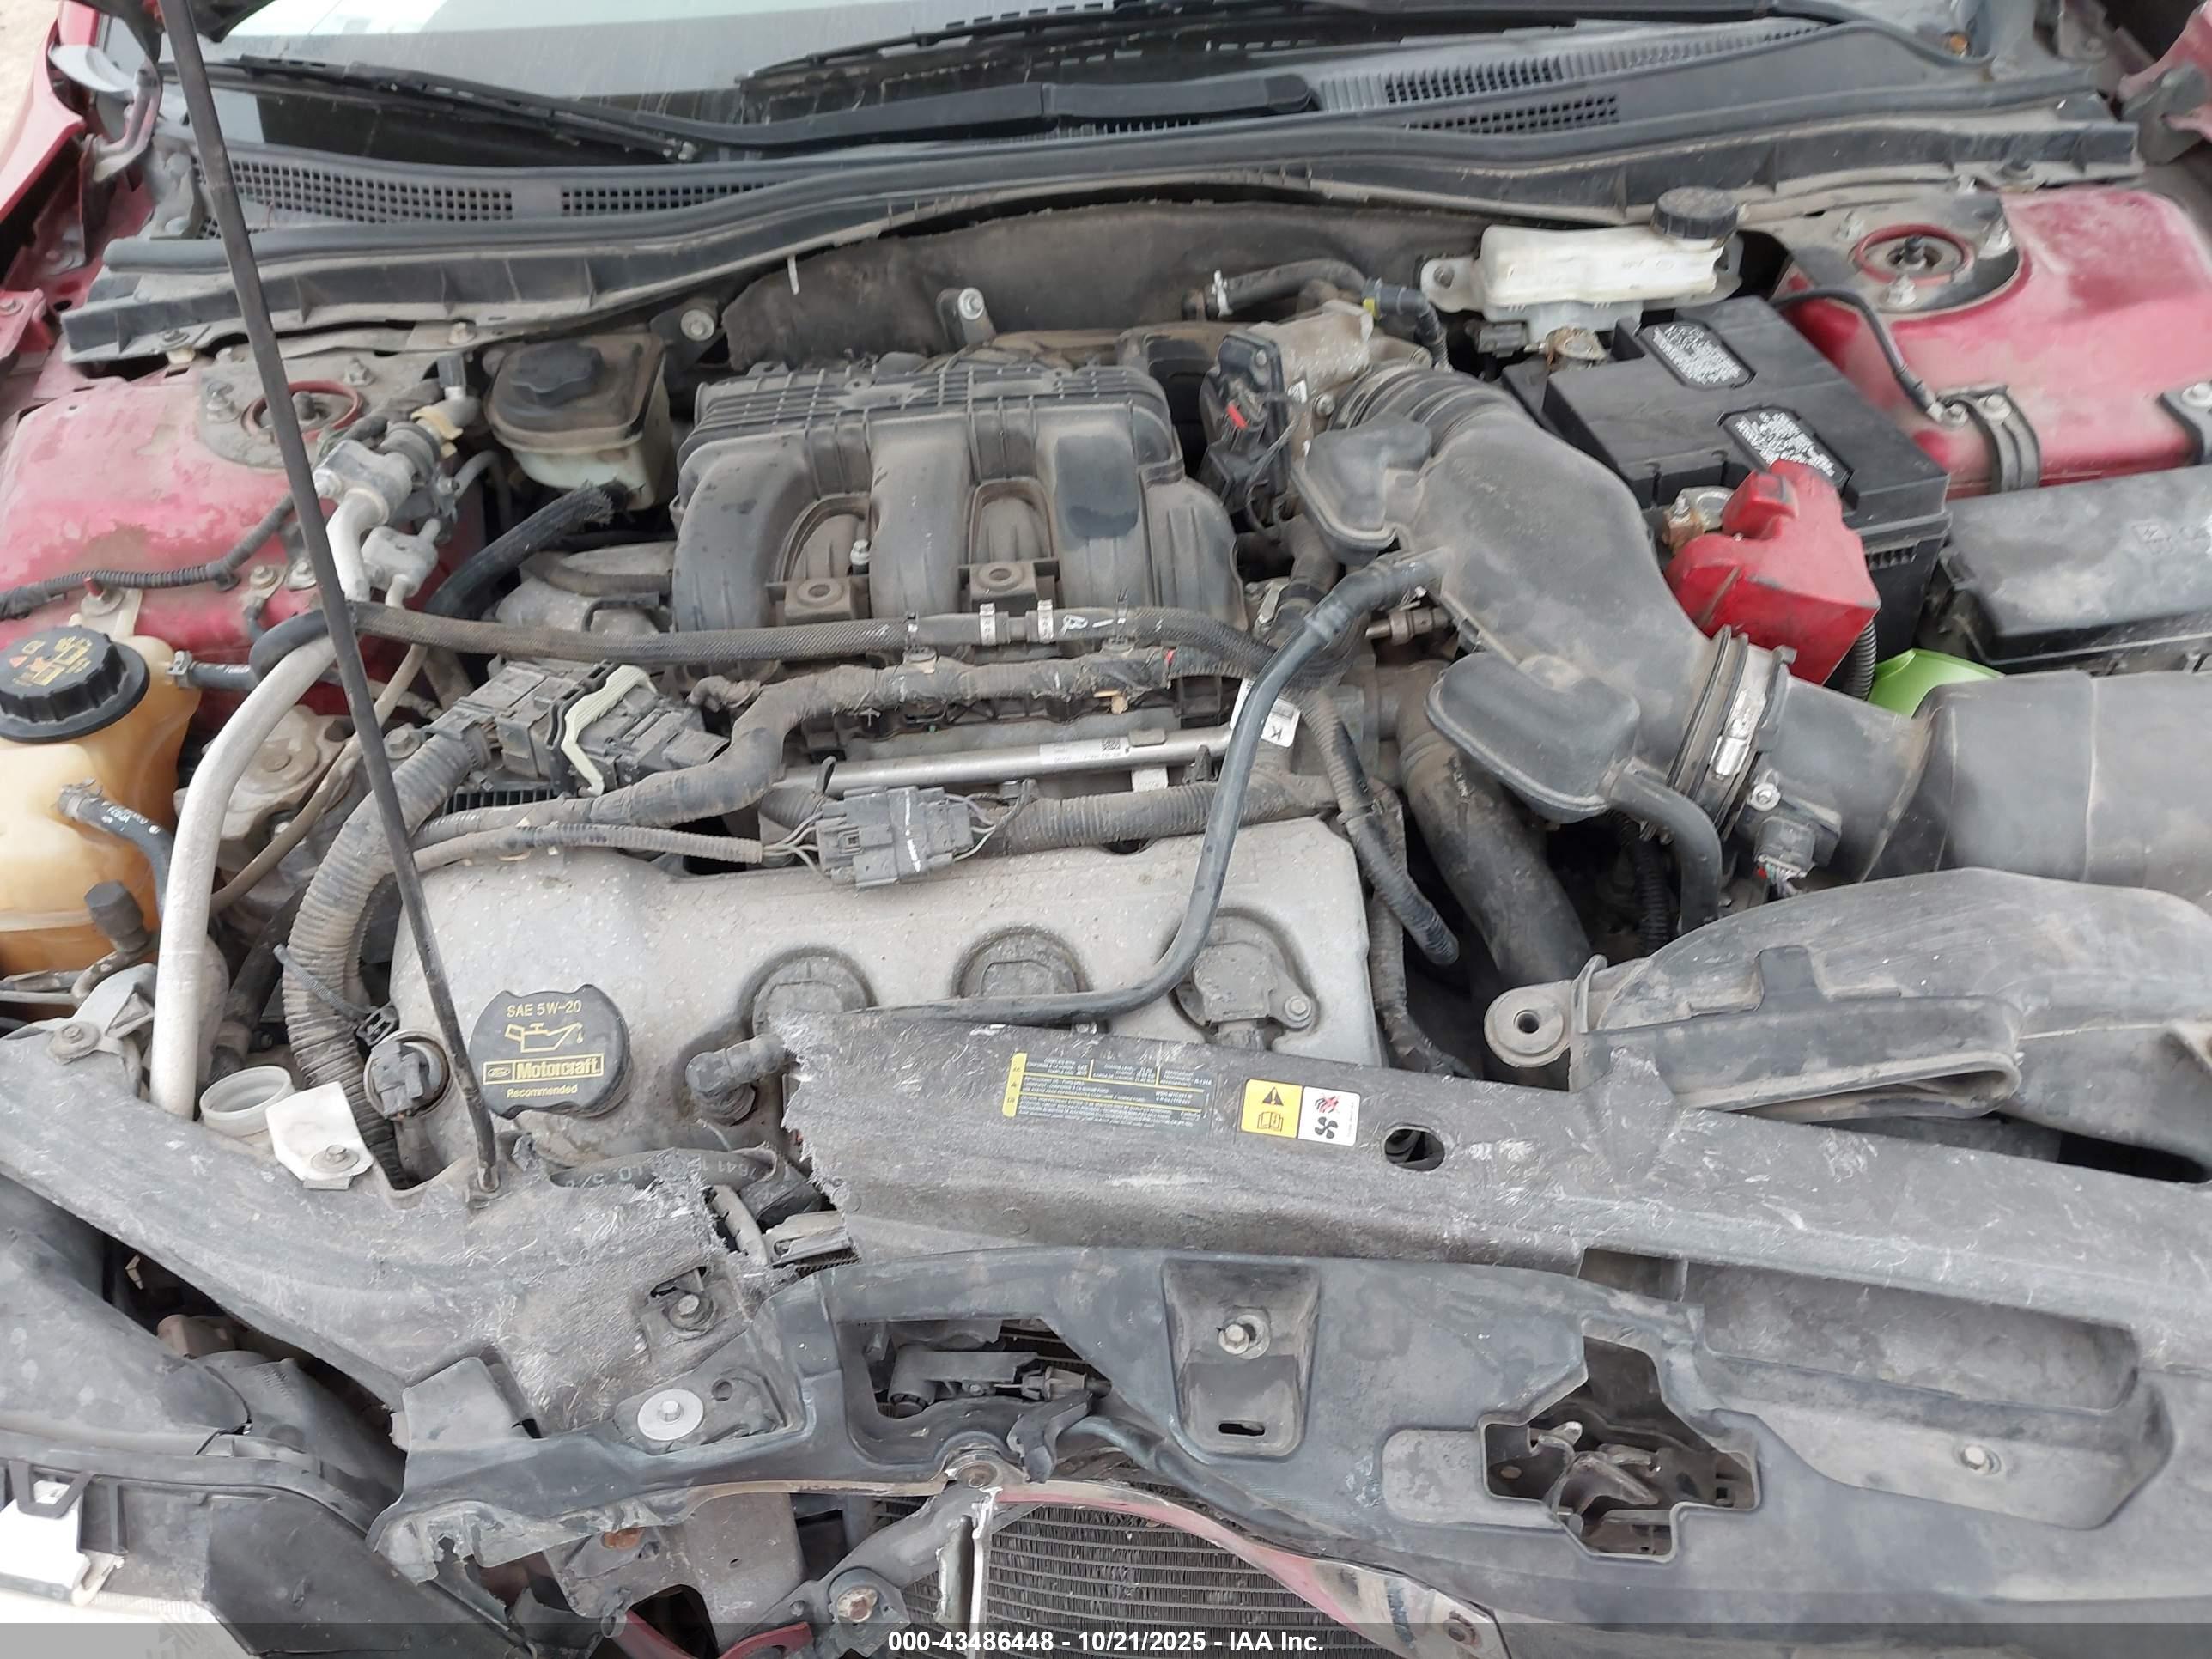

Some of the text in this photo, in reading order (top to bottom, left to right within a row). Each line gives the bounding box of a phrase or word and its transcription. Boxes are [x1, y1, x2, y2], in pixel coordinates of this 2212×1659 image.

[507, 1000, 582, 1018] SAE 5W-20
[516, 1057, 599, 1079] Motorcraft
[507, 1084, 578, 1098] Recommended
